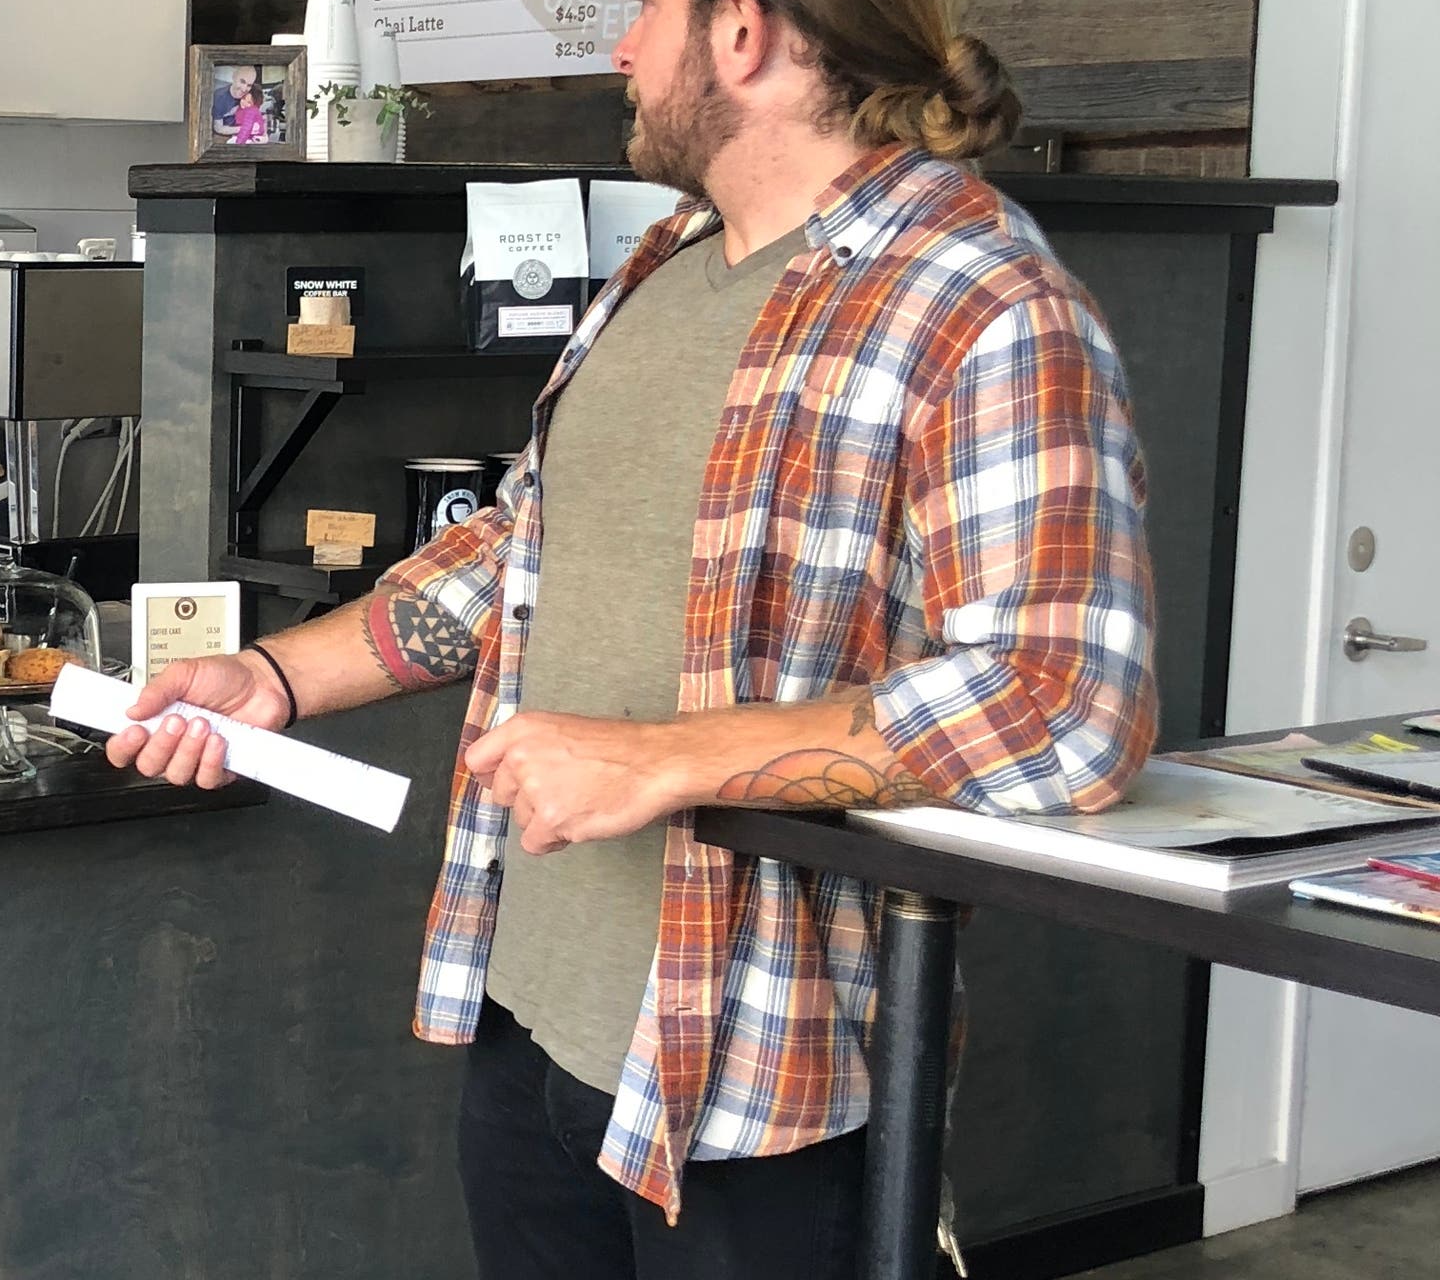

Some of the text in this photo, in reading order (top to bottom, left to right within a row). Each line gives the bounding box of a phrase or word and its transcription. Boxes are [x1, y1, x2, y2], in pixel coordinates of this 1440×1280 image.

[556, 4, 596, 23] $4.50
[408, 16, 444, 33] Latte
[555, 40, 595, 58] $2.50
[499, 234, 542, 243] ROAST
[294, 280, 358, 290] SNOW WHITE
